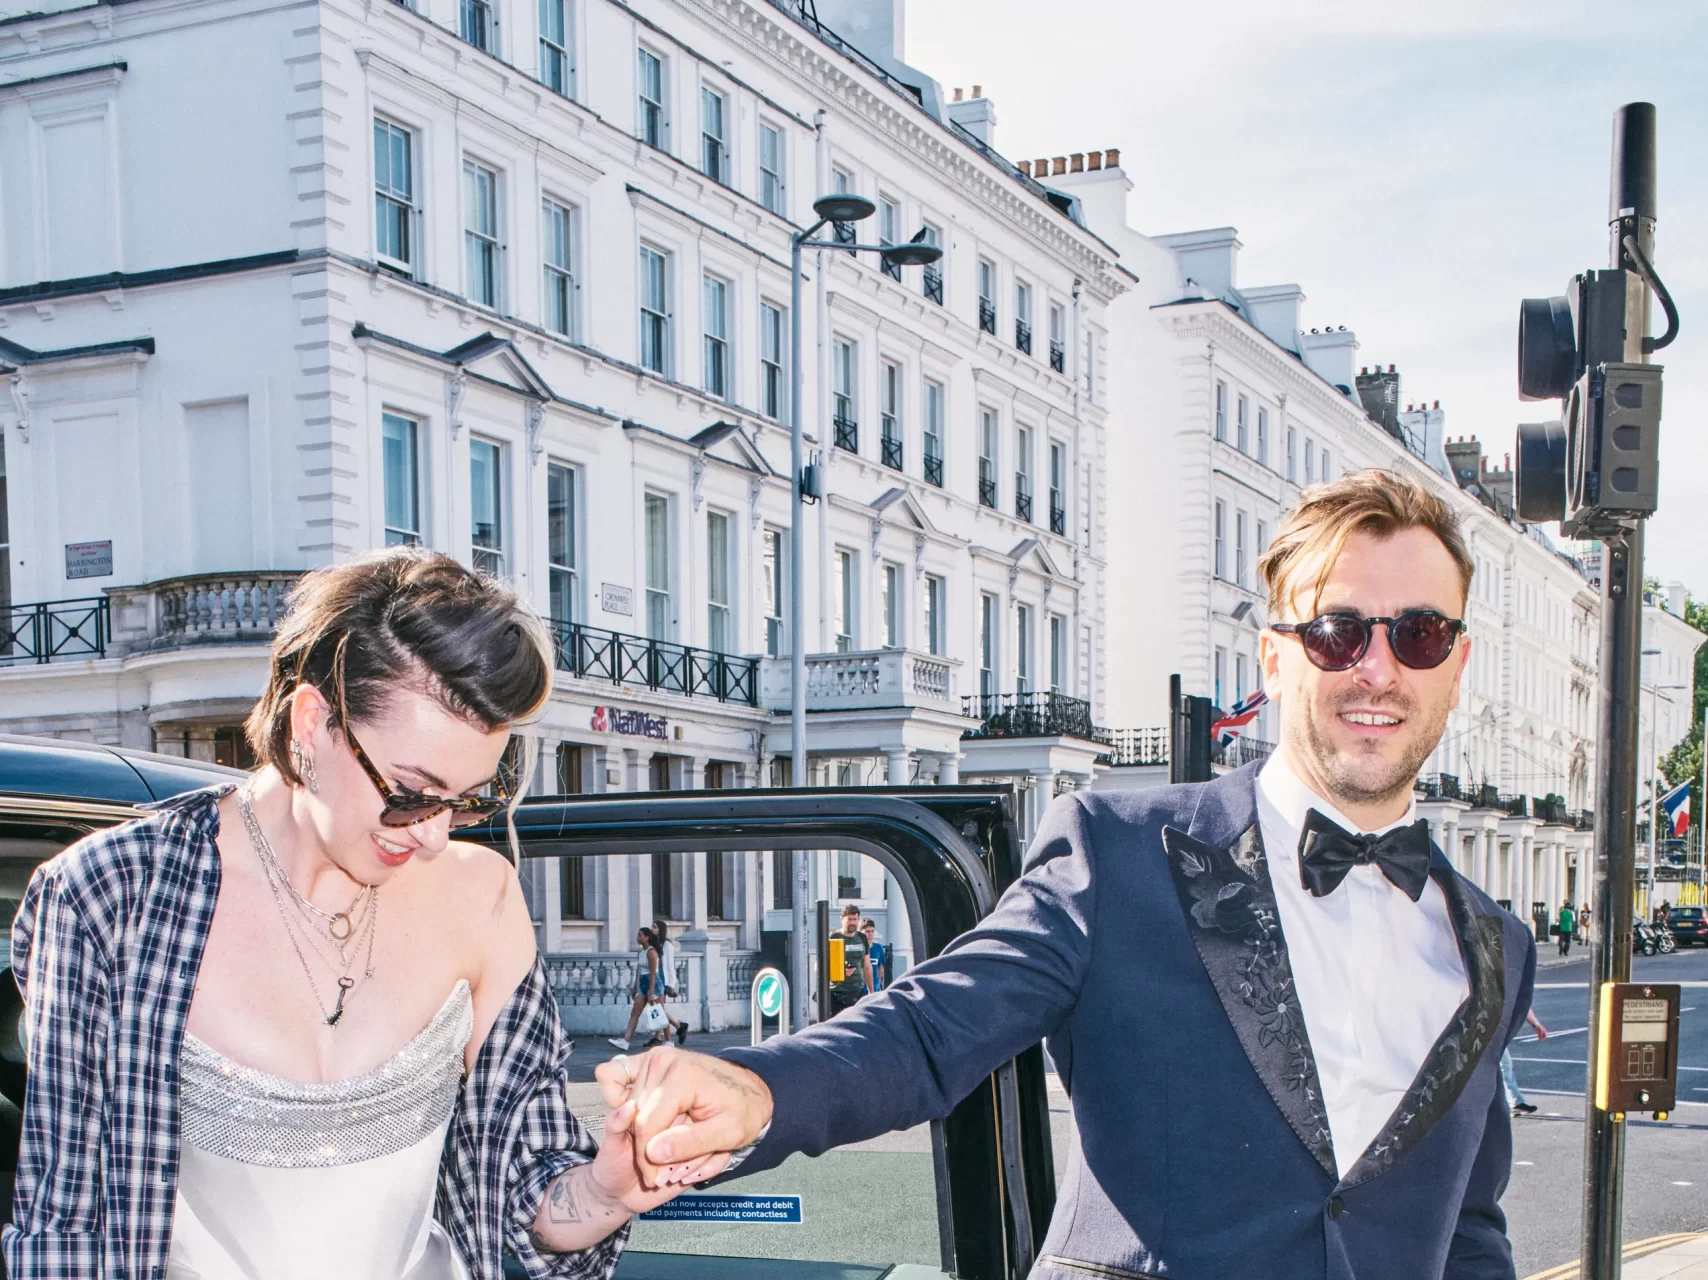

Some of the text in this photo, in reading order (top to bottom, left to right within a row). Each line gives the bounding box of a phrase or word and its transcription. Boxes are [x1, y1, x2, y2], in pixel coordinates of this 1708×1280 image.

[67, 557, 112, 567] HARRINGTON
[68, 568, 88, 577] ROAD
[609, 708, 669, 740] NatWest
[663, 1200, 678, 1208] taxi
[698, 1201, 729, 1210] accepts
[730, 1201, 755, 1209] credit
[755, 1201, 771, 1209] and
[772, 1201, 794, 1210] debit
[664, 1210, 703, 1218] payments
[704, 1210, 741, 1219] including
[741, 1211, 788, 1219] contactless
